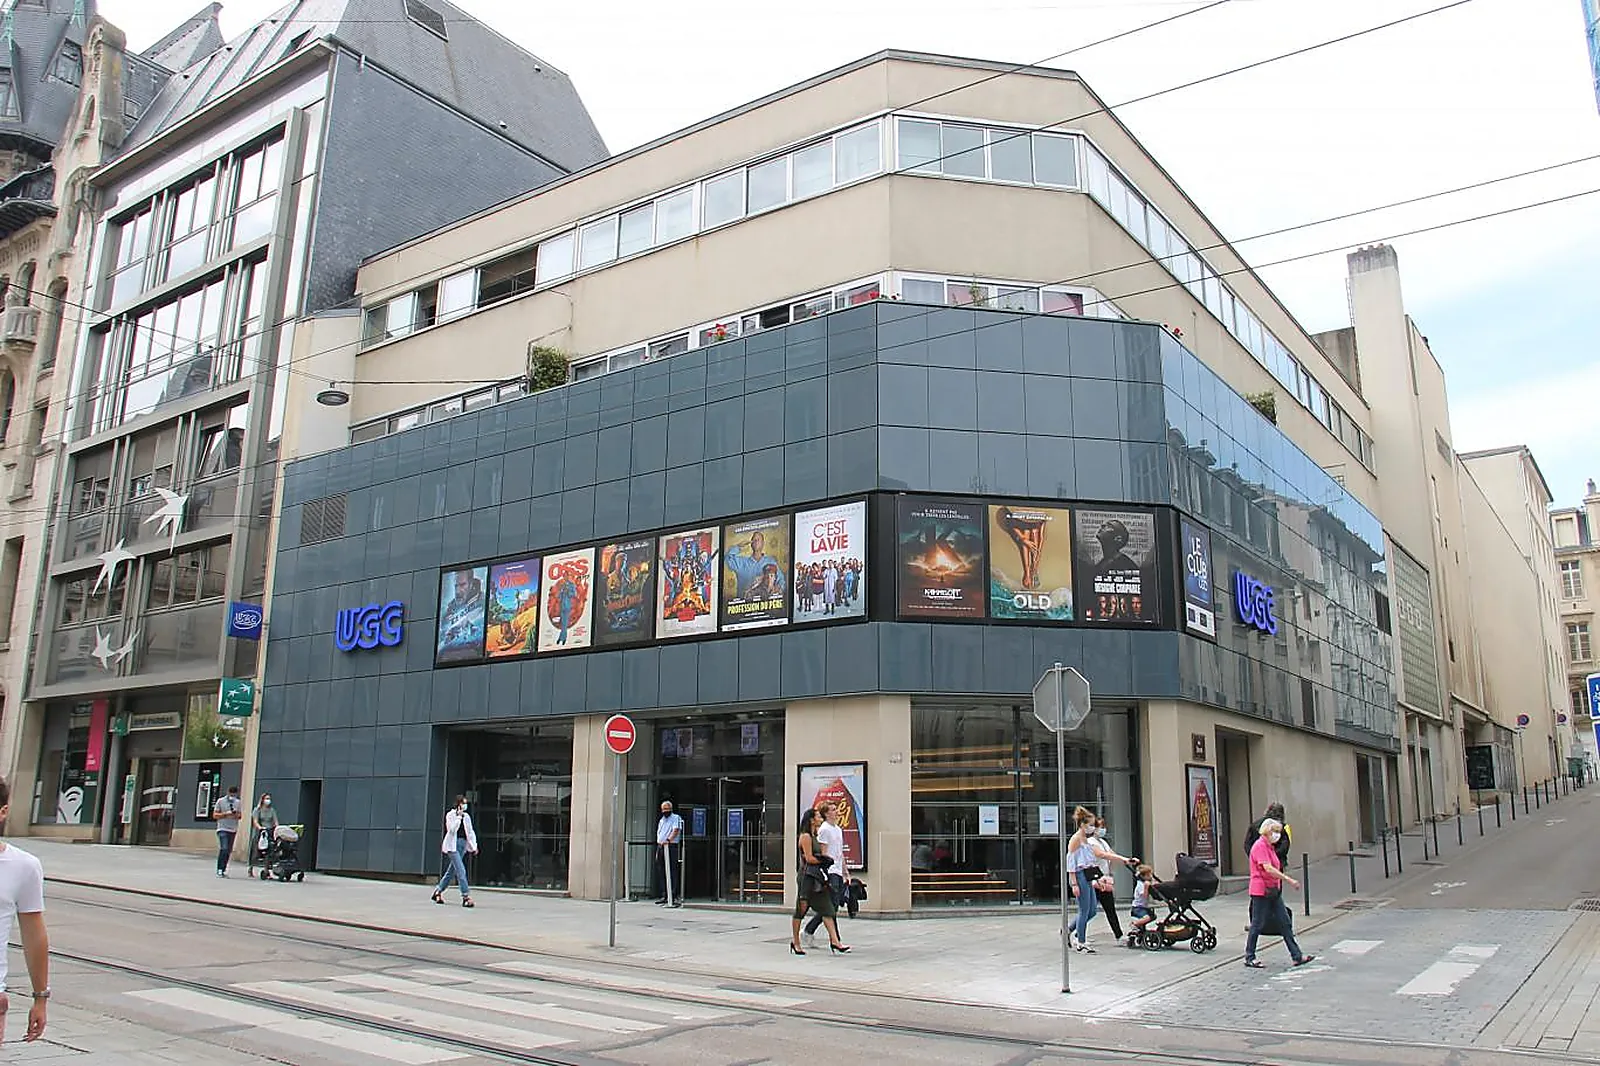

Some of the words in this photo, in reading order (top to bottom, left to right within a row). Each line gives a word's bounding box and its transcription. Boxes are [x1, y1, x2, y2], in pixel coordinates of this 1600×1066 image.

[813, 519, 847, 539] C'EST
[826, 534, 849, 551] VIE
[1191, 536, 1202, 556] LE
[548, 558, 589, 581] OSS
[1187, 553, 1208, 579] CLUB
[728, 601, 760, 615] PROFESSION
[760, 600, 768, 611] DU
[1014, 594, 1052, 610] OLD
[1235, 570, 1278, 635] UGC
[336, 600, 403, 651] UGC
